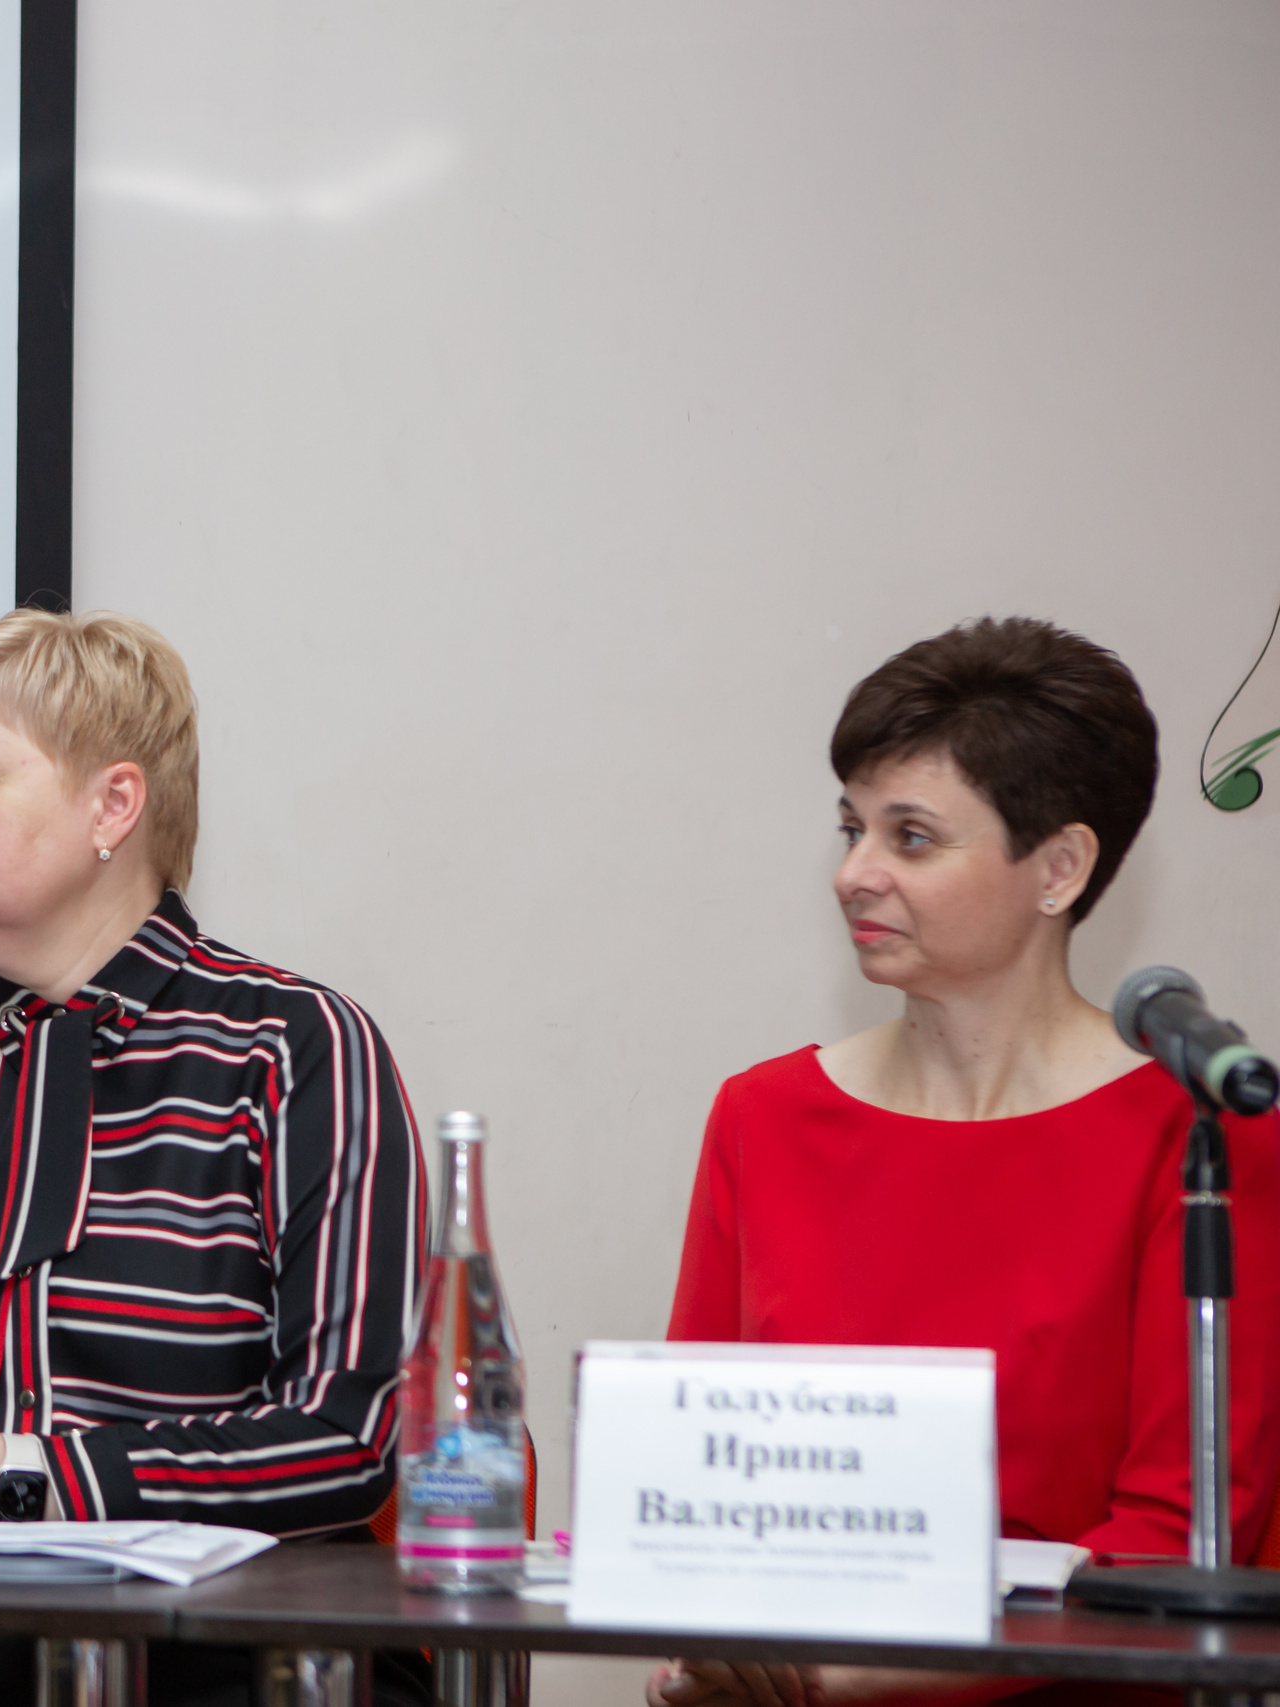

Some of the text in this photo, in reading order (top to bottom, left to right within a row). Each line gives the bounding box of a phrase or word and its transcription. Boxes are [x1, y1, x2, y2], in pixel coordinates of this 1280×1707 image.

[672, 1376, 899, 1426] Голубева
[702, 1434, 863, 1477] Ирина
[636, 1488, 931, 1540] Валериевна
